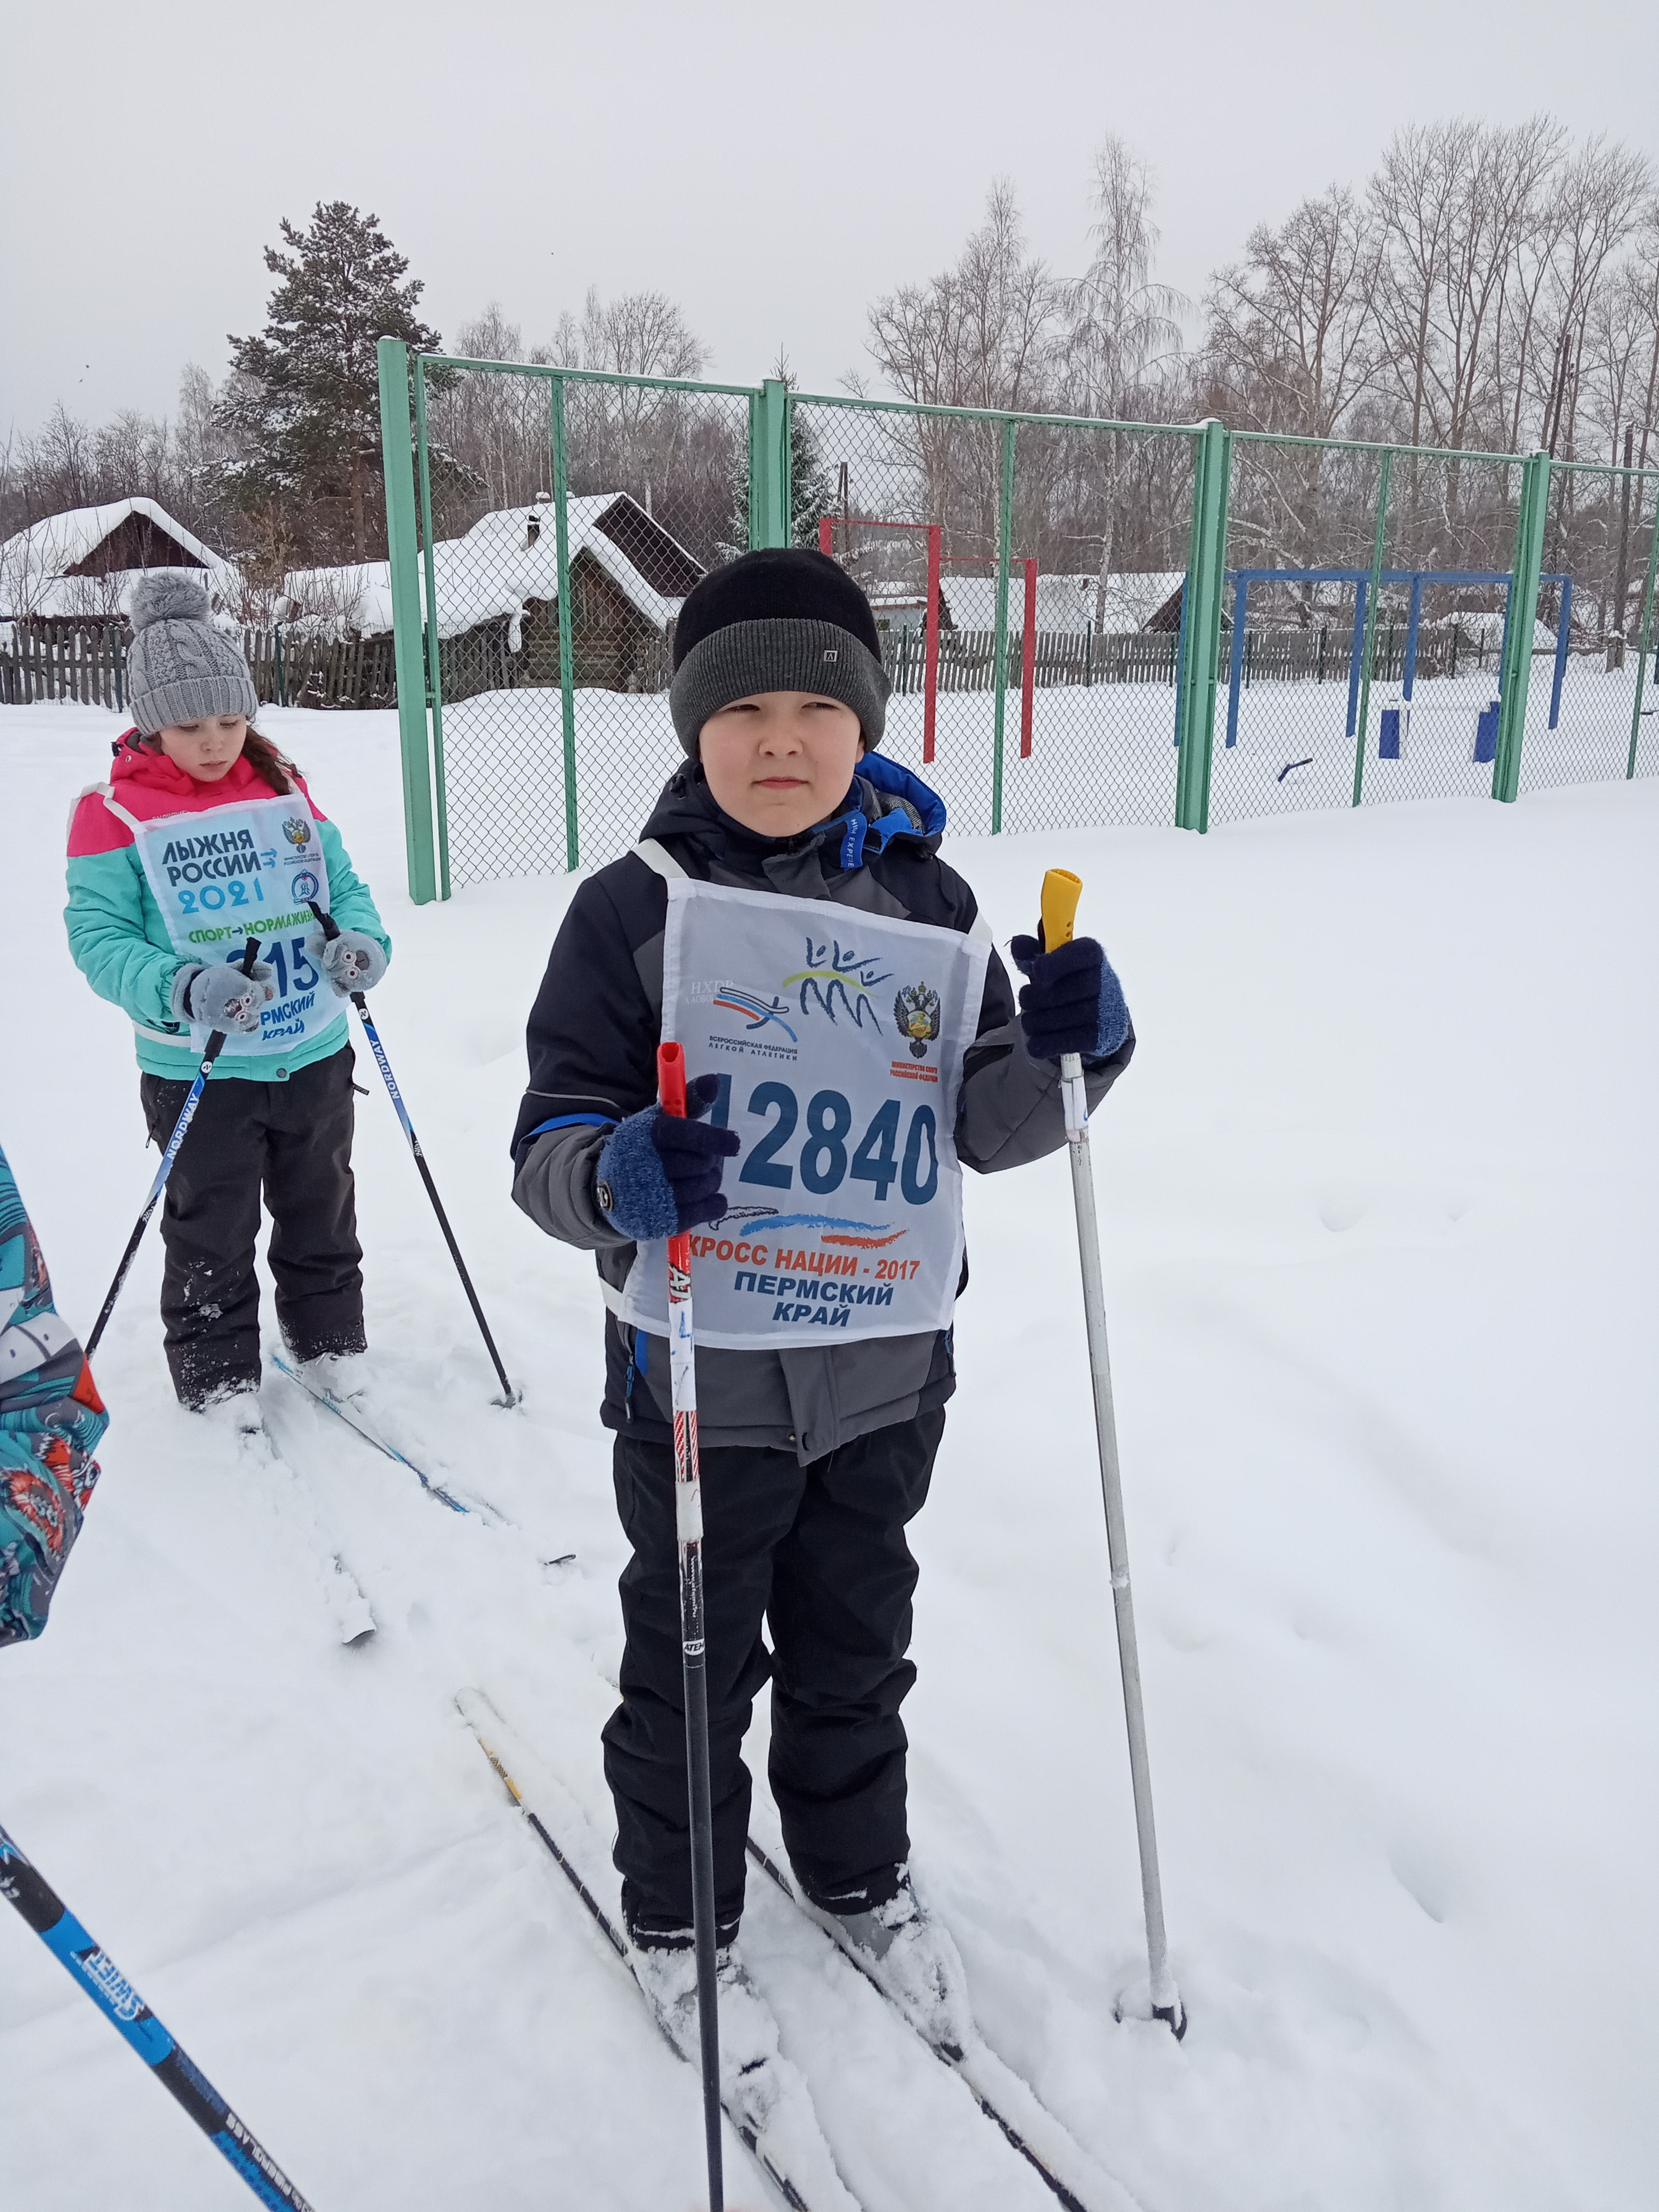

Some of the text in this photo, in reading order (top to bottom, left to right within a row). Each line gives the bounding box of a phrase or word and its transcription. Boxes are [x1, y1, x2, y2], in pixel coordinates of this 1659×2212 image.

[162, 829, 255, 865] ЛЫЖНЯ
[166, 851, 262, 887] РОССИИ
[178, 877, 264, 915] 2021
[188, 926, 232, 943] СПОРТ
[260, 990, 315, 1026] РМСКИЙ
[262, 1017, 305, 1041] КРАЙ
[709, 1035, 798, 1054] ВСЕРОССИЙСКАЯ ФЕДЕРАЦИЯ
[369, 1038, 401, 1100] NORDWAY
[708, 1042, 798, 1061] ЛЕГКОЙ АТЛЕТИКИ
[166, 1092, 200, 1161] NORDWAY
[690, 1235, 768, 1266] КРОСС
[775, 1250, 858, 1277] НАЦИИ
[874, 1259, 920, 1280] 2017
[734, 1270, 894, 1307] ПЕРМСКИЙ
[772, 1302, 851, 1327] КРАЙ
[82, 1950, 145, 2021] SWIFT
